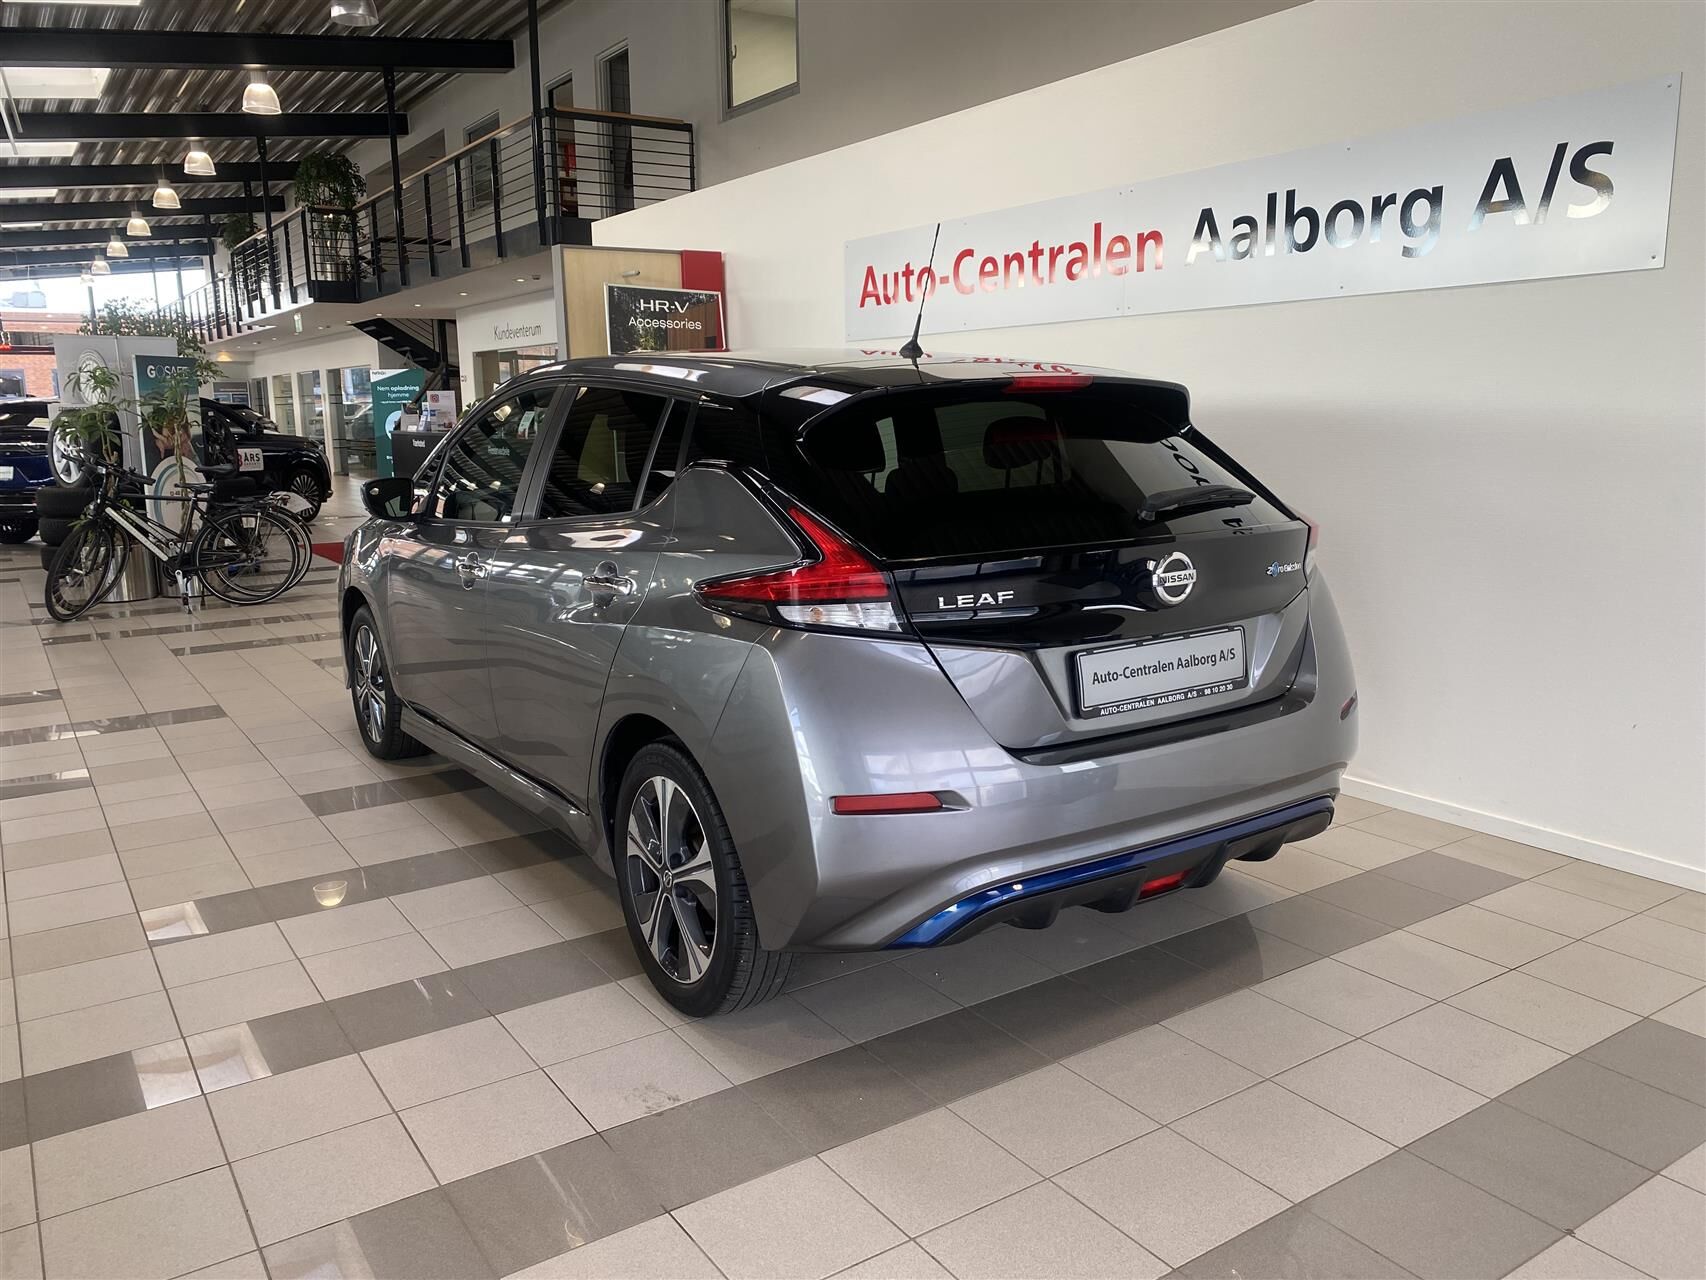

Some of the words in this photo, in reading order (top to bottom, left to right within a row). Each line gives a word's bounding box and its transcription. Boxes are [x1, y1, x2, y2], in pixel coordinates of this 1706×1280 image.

[859, 222, 1163, 308] Auto-Centralen
[1184, 185, 1444, 267] Aalborg
[1468, 140, 1615, 232] A/S
[640, 298, 689, 314] HR-V
[628, 316, 702, 330] Accessories
[1159, 571, 1195, 586] NISSAN
[938, 590, 1015, 610] LEAF
[1092, 660, 1175, 685] Auto-Centralen
[1177, 653, 1217, 667] Aalborg
[1219, 648, 1236, 662] A/S
[1100, 698, 1155, 716] AUTO-CENTRALEN
[1158, 693, 1185, 705] AALBORG
[1187, 690, 1198, 699] A/S
